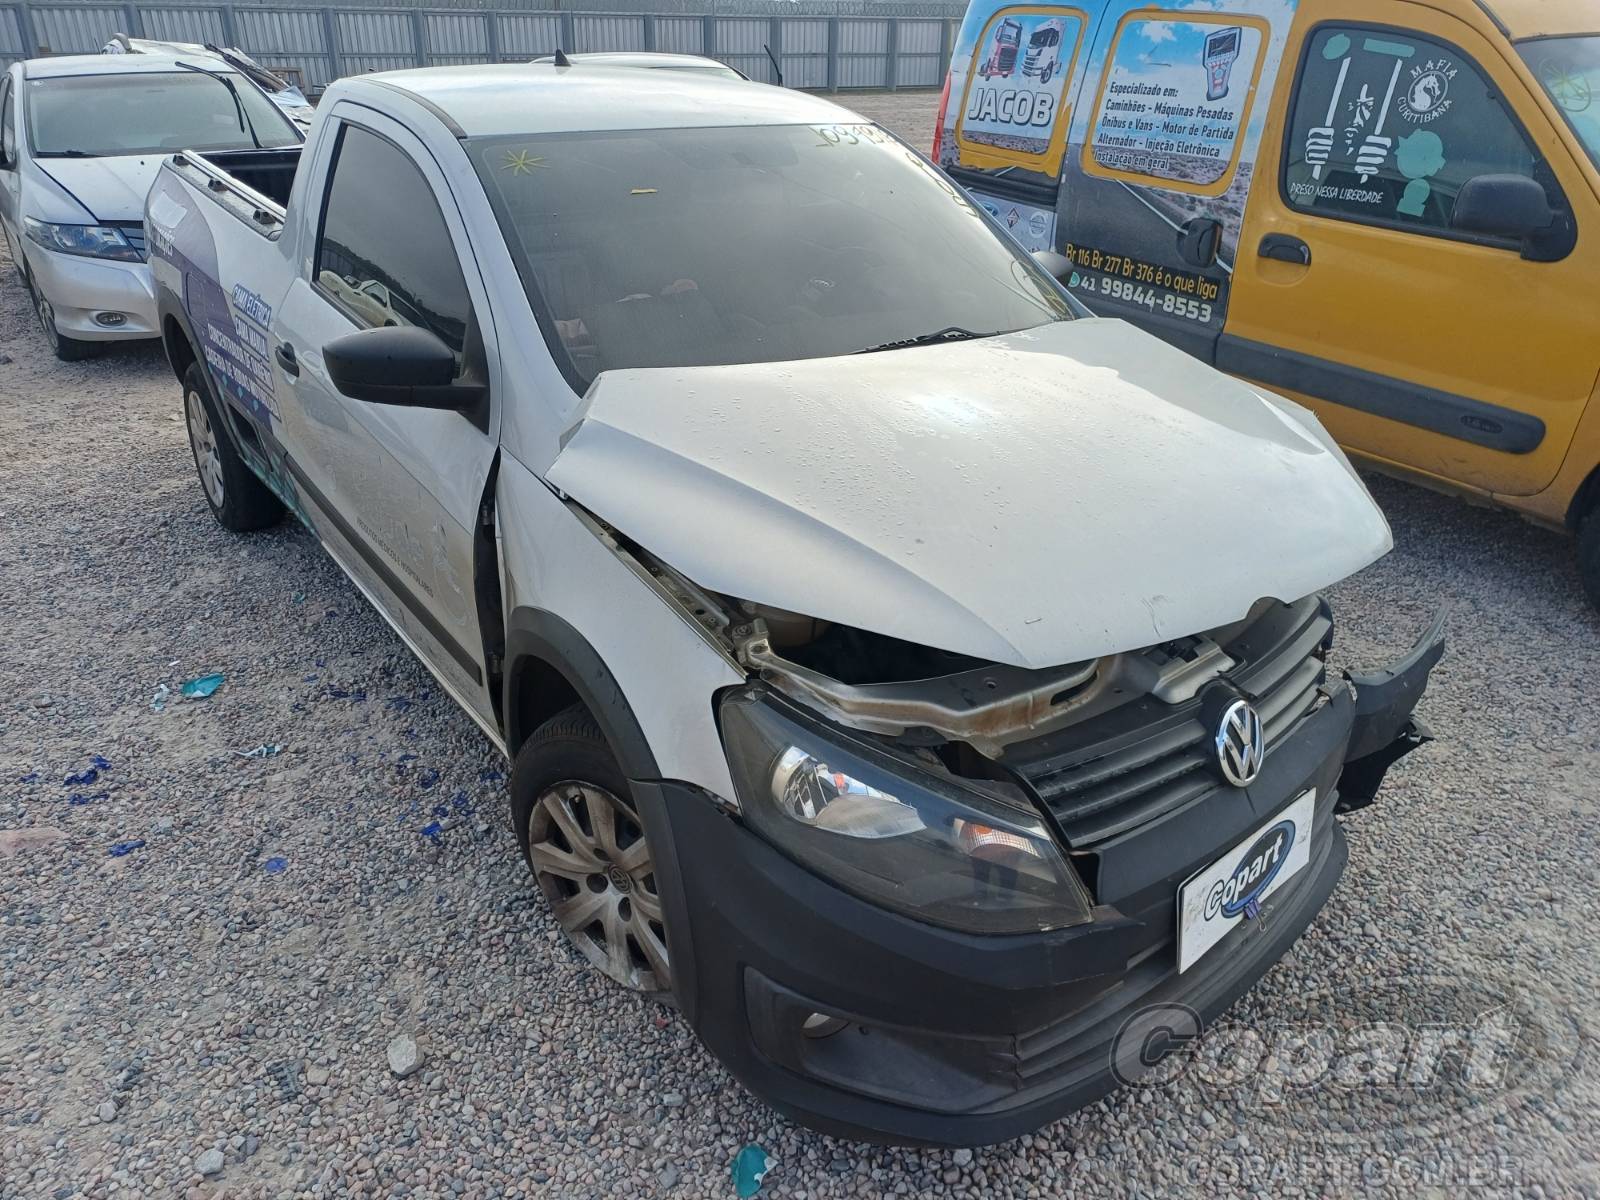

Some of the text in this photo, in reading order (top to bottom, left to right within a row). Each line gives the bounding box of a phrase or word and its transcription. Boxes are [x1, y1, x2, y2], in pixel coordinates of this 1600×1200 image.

[1410, 59, 1458, 80] MAFIA
[1109, 81, 1179, 97] Especializado em:
[968, 88, 1054, 127] JACOB
[1105, 98, 1146, 113] Caminhões
[1154, 102, 1194, 118] Máquinas
[1196, 105, 1234, 121] Pesadas
[1397, 96, 1452, 123] CURITIBANA
[1101, 113, 1126, 129] Ônibus
[1128, 120, 1133, 129] e
[1135, 118, 1153, 131] Vans
[1162, 121, 1186, 135] Motor
[1188, 124, 1199, 136] de
[1201, 125, 1234, 140] Partida
[1097, 132, 1137, 147] Alternador
[1145, 138, 1174, 153] Injeção
[1176, 141, 1220, 158] Eletrônica
[1134, 156, 1146, 165] em
[1147, 158, 1169, 170] geral
[1290, 182, 1384, 204] PRESO NESSA LIBERDADE
[1066, 243, 1218, 300] Br 116 Br 277 Br 376 é o que liga
[1080, 276, 1212, 323] 41 99844-8553
[1204, 832, 1284, 922] Copart
